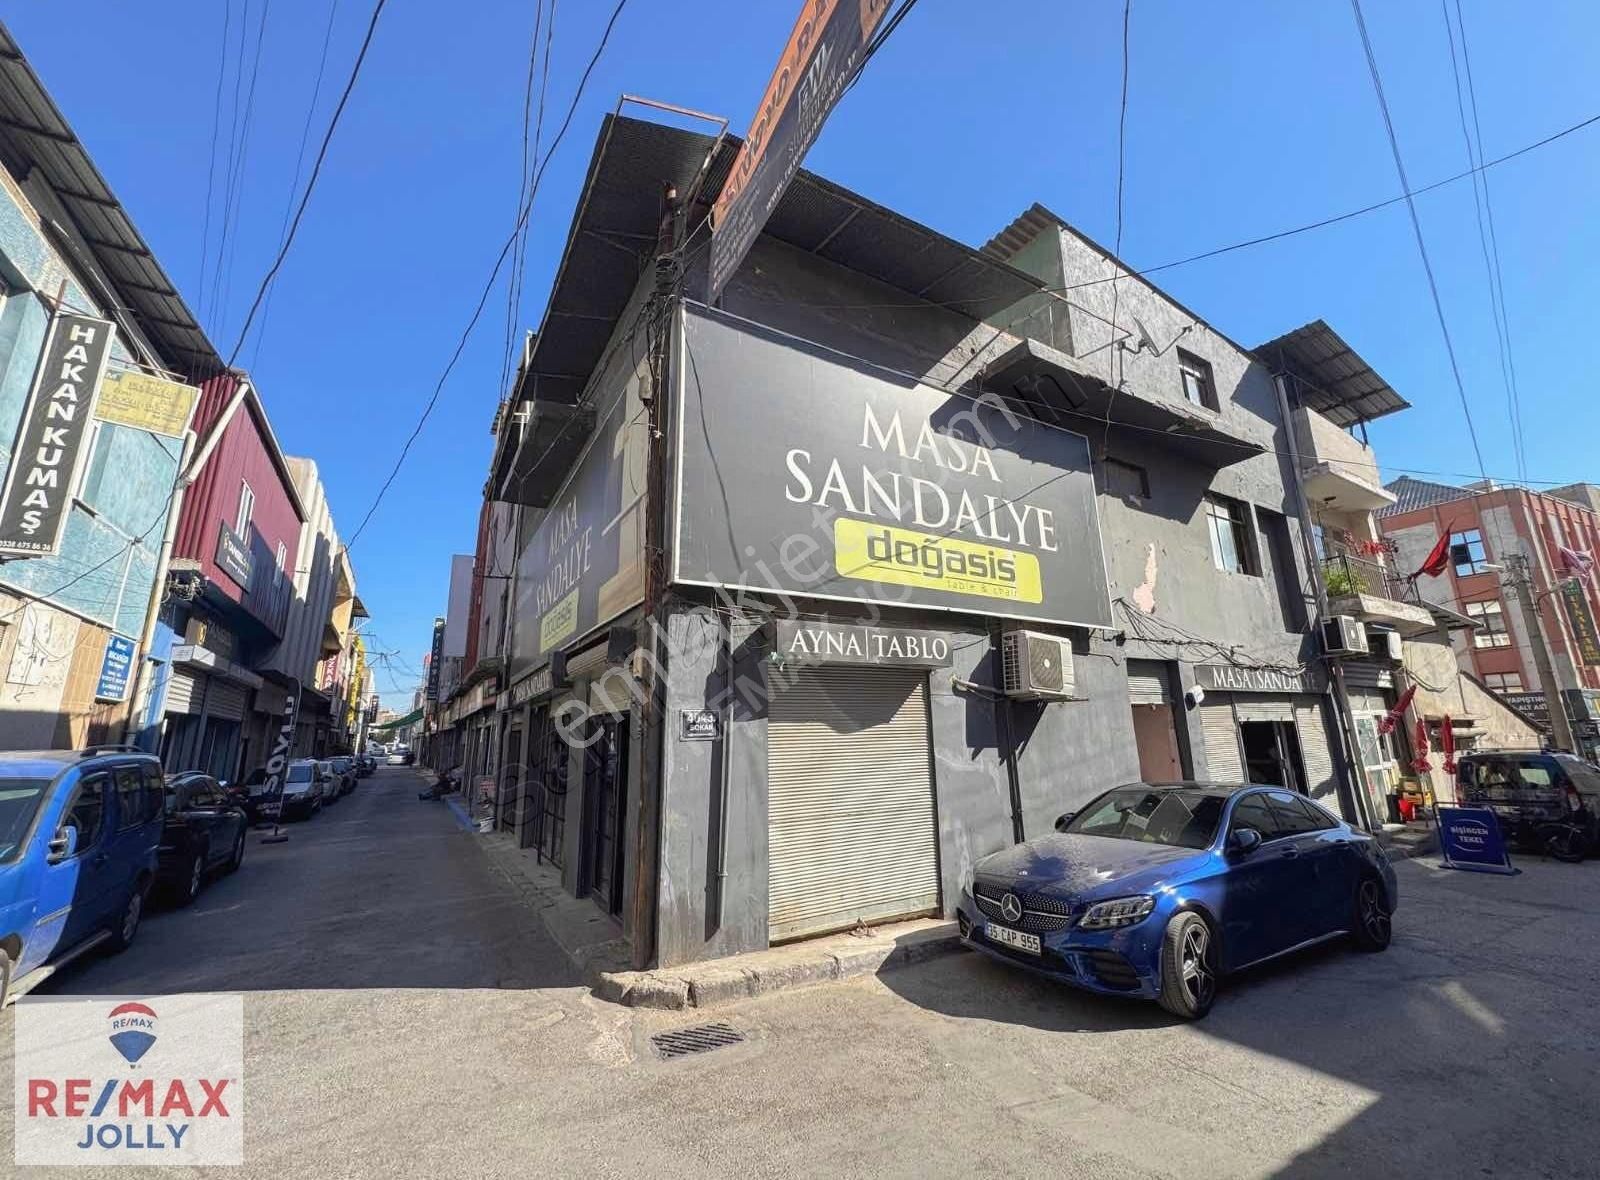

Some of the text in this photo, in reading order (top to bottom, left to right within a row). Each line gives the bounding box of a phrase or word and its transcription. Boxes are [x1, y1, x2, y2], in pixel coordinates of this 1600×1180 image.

[47, 324, 96, 422] HAKAN
[859, 401, 1002, 483] MASA
[20, 426, 70, 535] KUMAŞ
[784, 449, 1058, 552] SANDALYE
[866, 529, 1016, 582] doğasis
[788, 629, 948, 660] AYNA TABLO
[1213, 667, 1253, 689] MASA
[1020, 934, 1040, 951] 955
